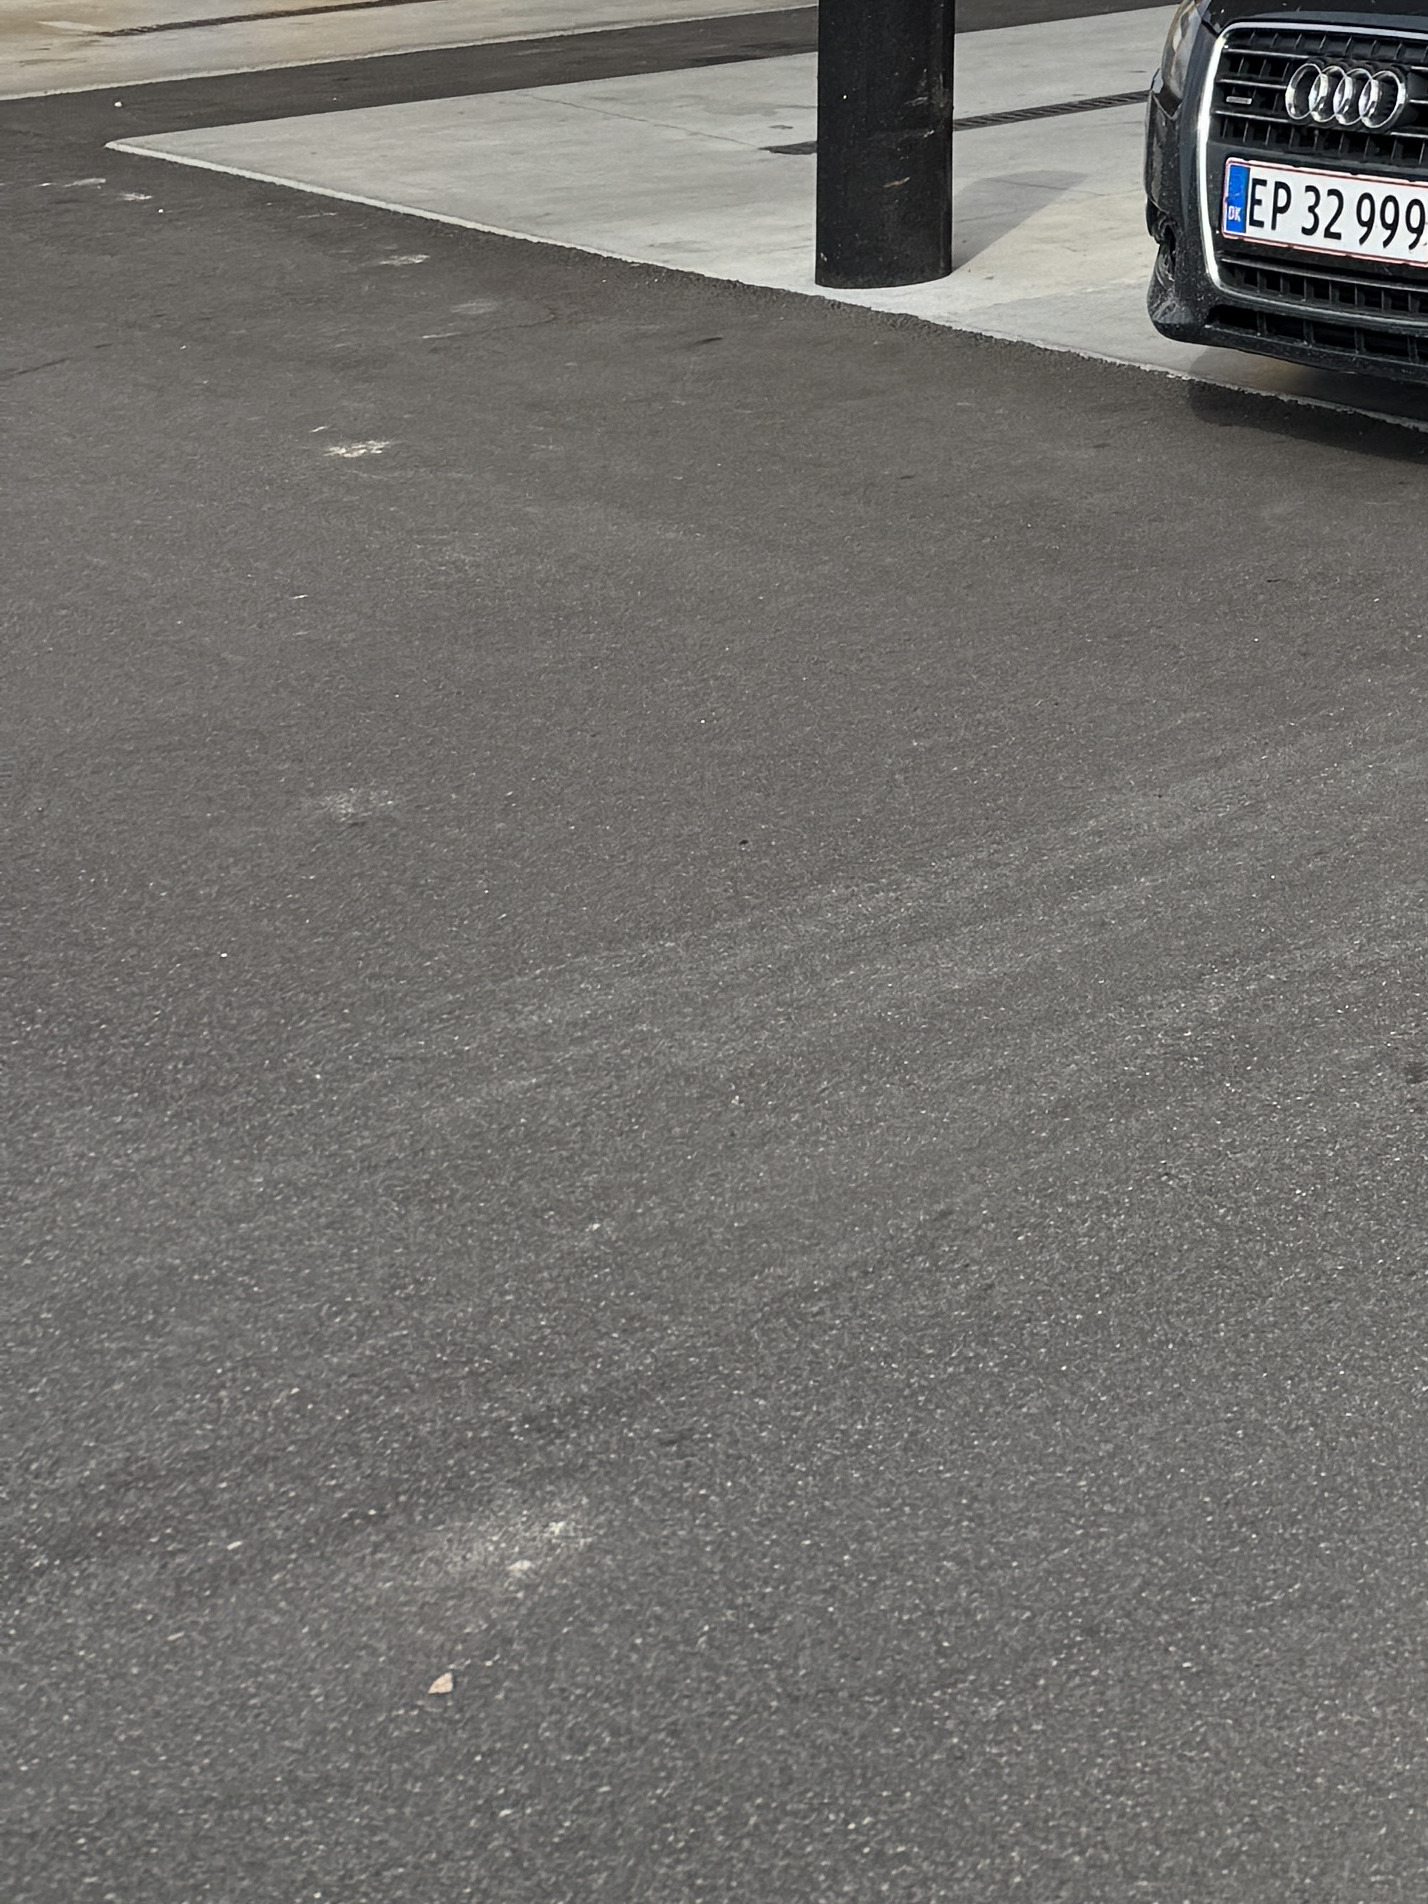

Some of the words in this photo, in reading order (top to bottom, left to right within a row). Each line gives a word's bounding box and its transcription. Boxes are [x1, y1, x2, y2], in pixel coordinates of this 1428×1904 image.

[1227, 204, 1243, 223] DK
[1249, 177, 1292, 230] EP
[1301, 185, 1344, 240] 32
[1356, 191, 1427, 250] 999
